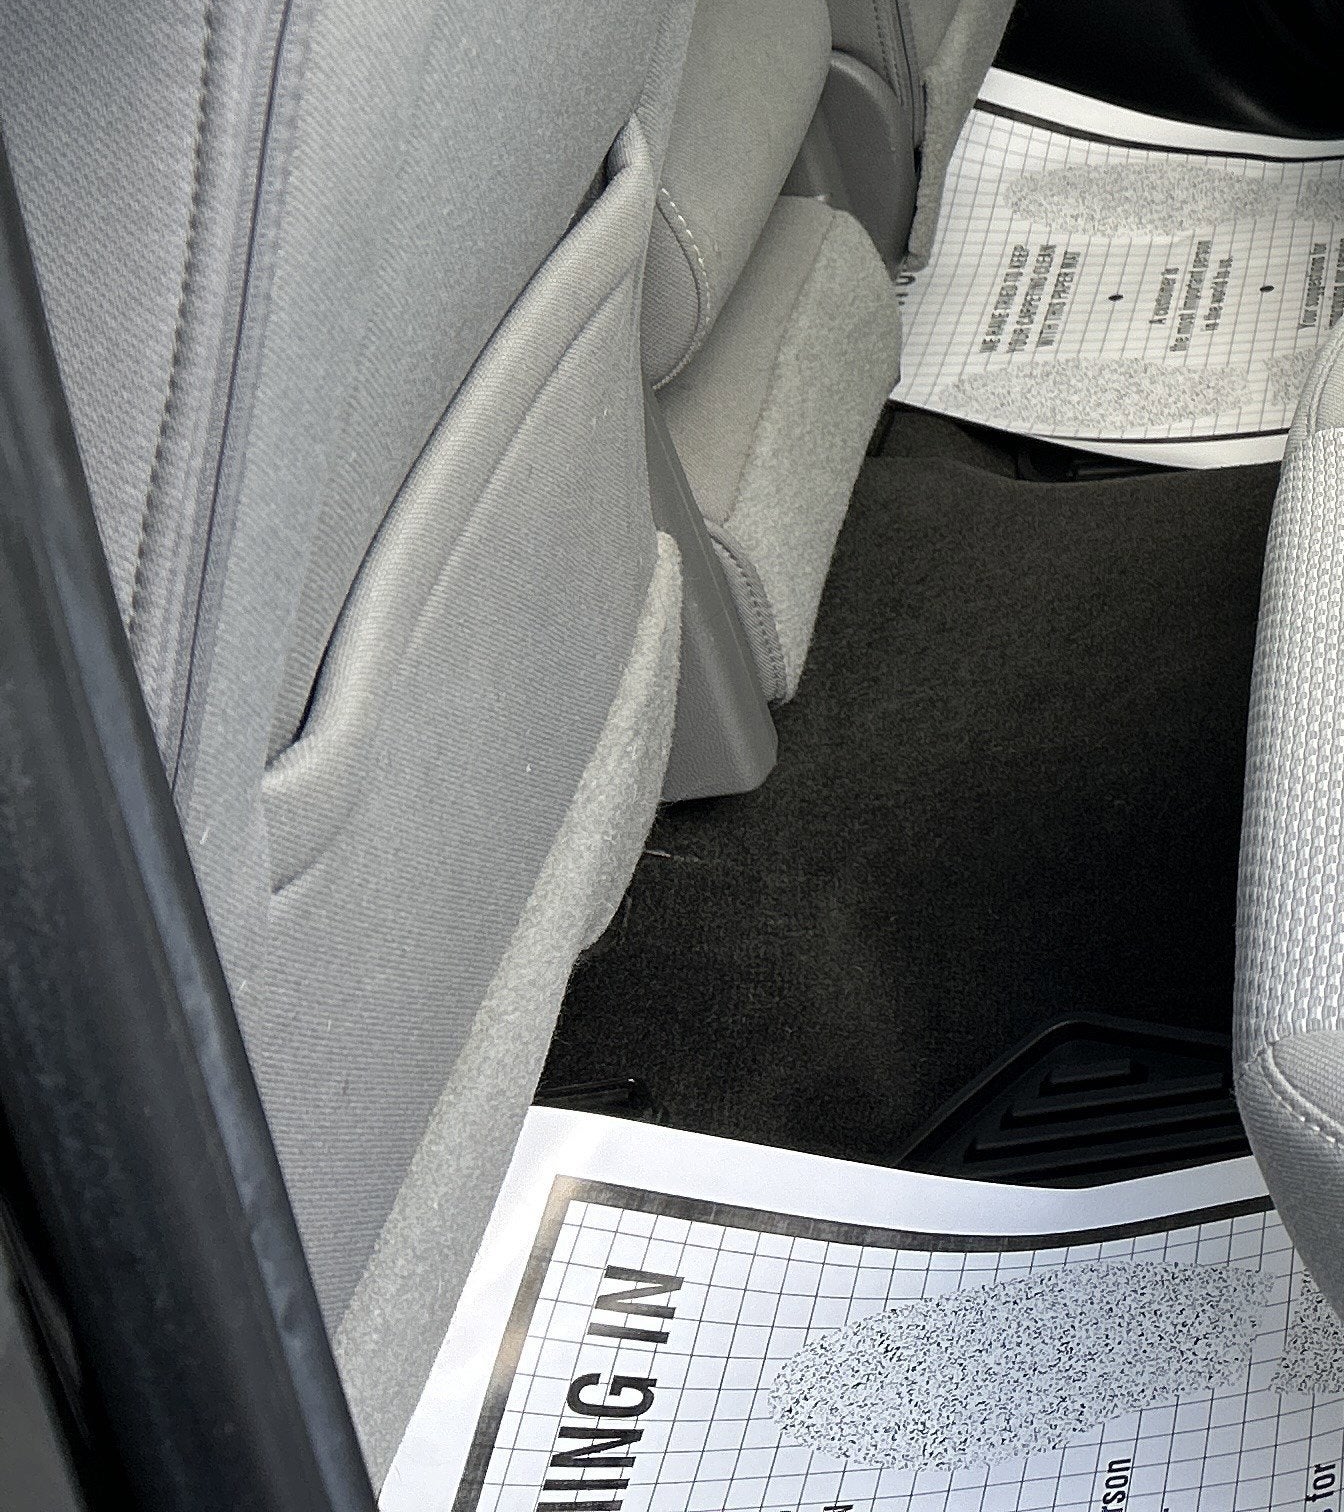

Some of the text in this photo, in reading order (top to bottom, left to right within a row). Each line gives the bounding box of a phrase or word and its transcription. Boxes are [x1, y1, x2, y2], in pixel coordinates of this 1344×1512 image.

[1008, 244, 1029, 269] KEEP
[1051, 272, 1075, 300] PAPER
[1298, 309, 1317, 330] Your
[1309, 243, 1326, 255] for
[1006, 328, 1031, 353] YOUR
[1033, 244, 1056, 274] CLEAN
[587, 1264, 685, 1345] IN
[1304, 1463, 1337, 1502] for
